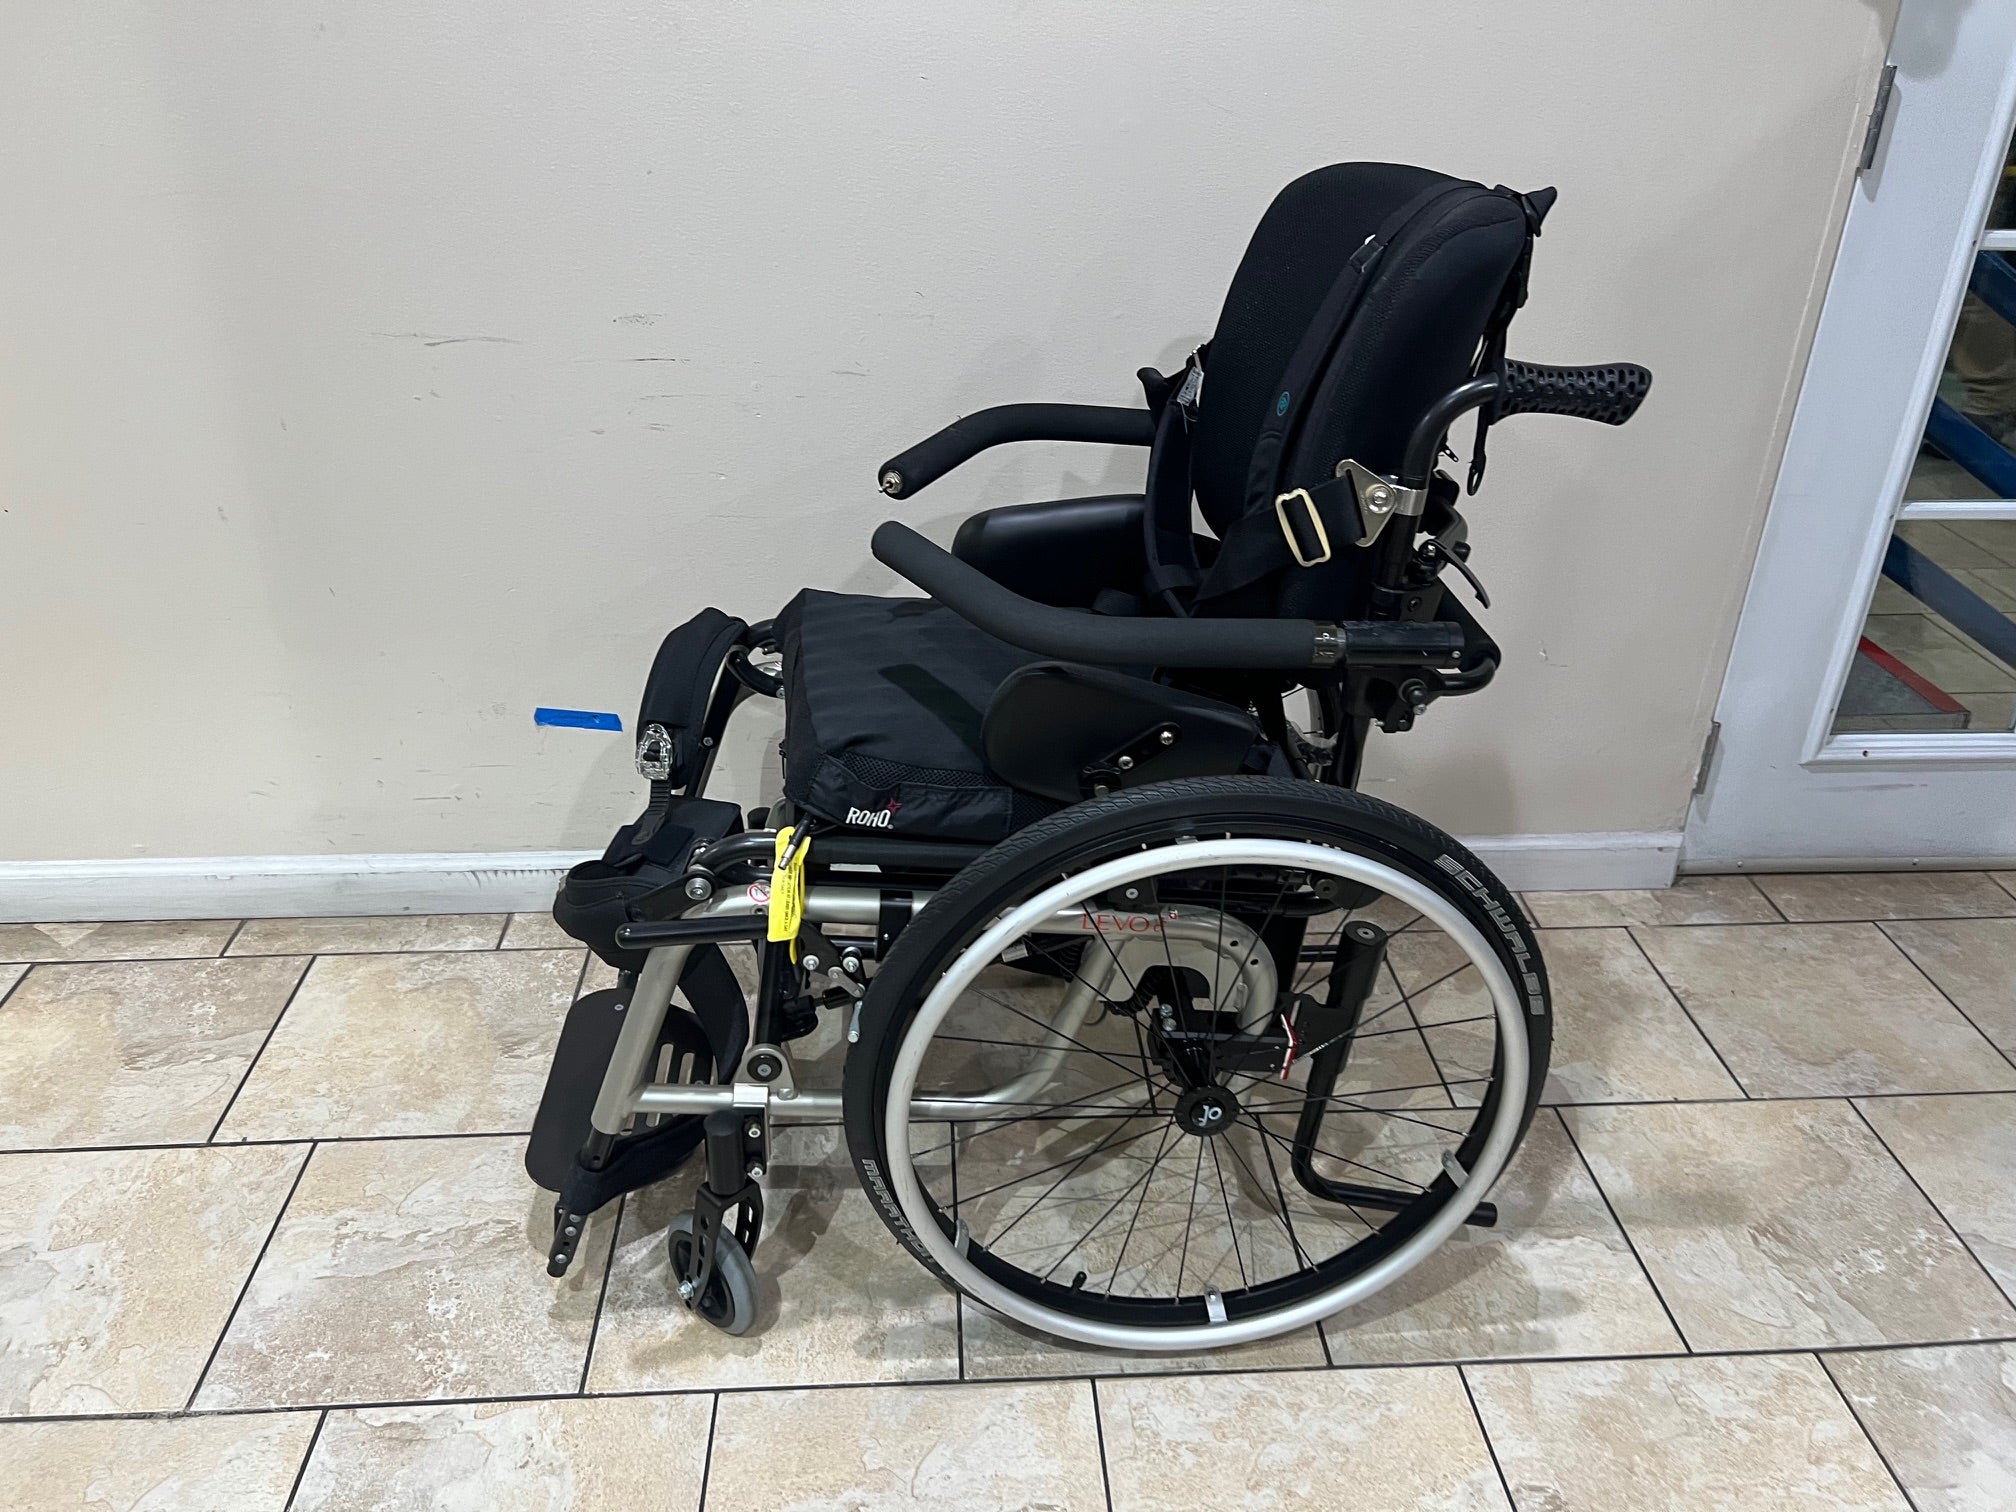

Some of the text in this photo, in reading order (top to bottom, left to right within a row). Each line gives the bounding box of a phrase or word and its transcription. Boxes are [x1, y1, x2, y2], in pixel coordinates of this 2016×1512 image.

[845, 806, 892, 828] ROHO
[1081, 913, 1150, 932] LEVO
[1433, 853, 1545, 1016] SCHWALBE
[861, 1158, 935, 1264] MARATHO
